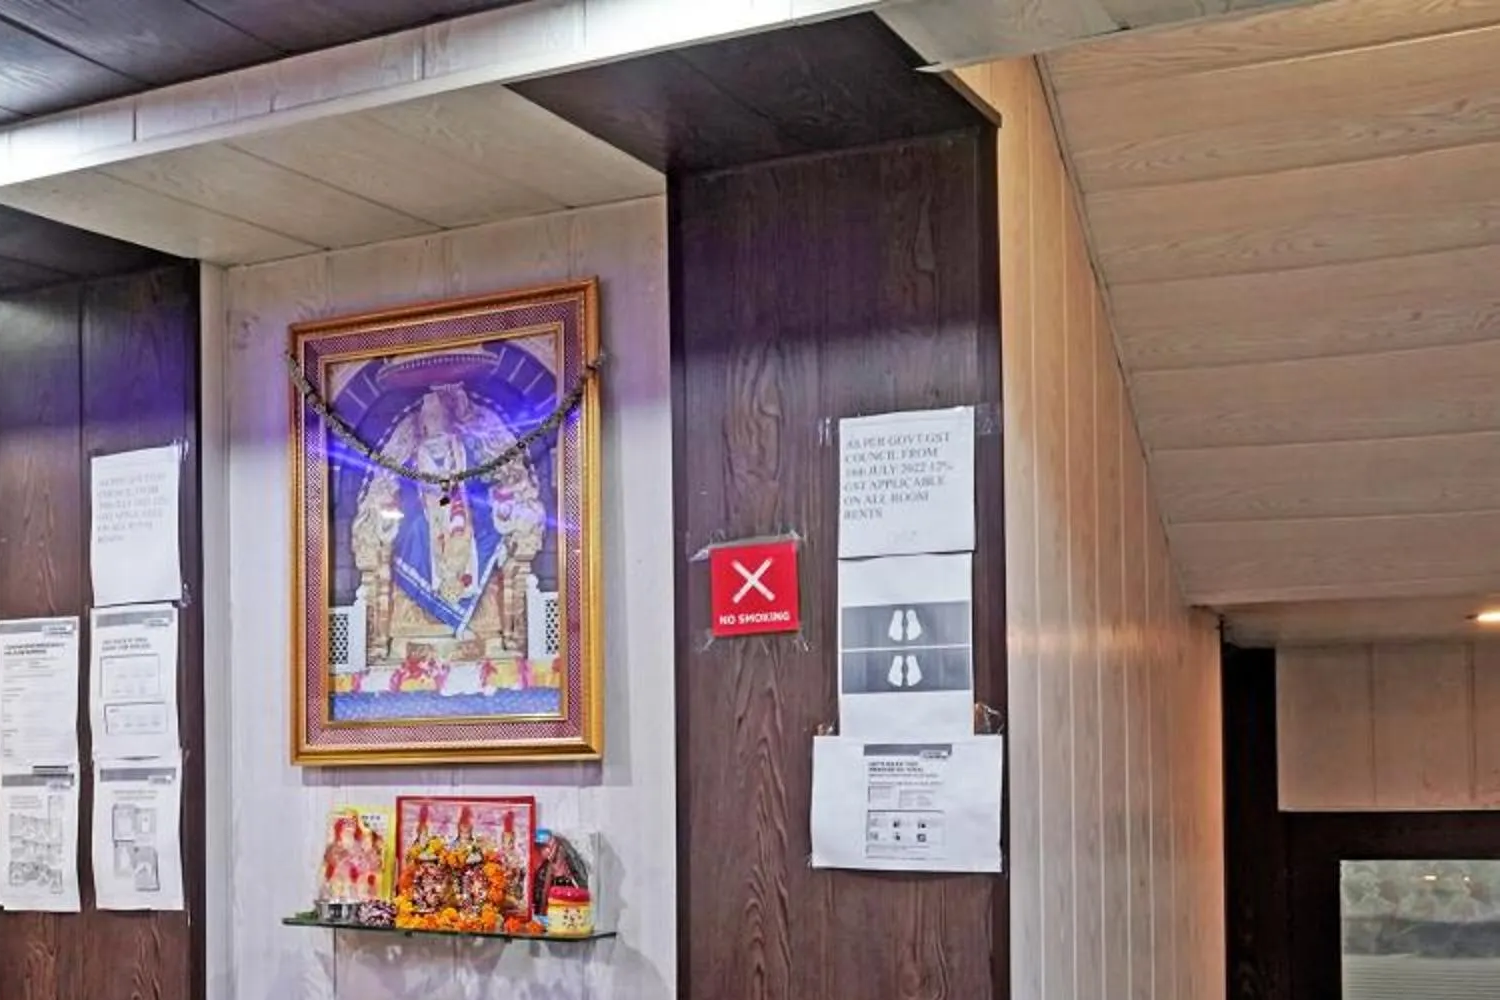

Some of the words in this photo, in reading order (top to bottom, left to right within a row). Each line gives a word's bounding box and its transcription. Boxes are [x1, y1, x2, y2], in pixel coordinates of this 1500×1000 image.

[901, 447, 938, 459] FROM
[868, 464, 896, 475] JULY
[719, 614, 736, 625] NO
[738, 611, 790, 624] SMOKING
